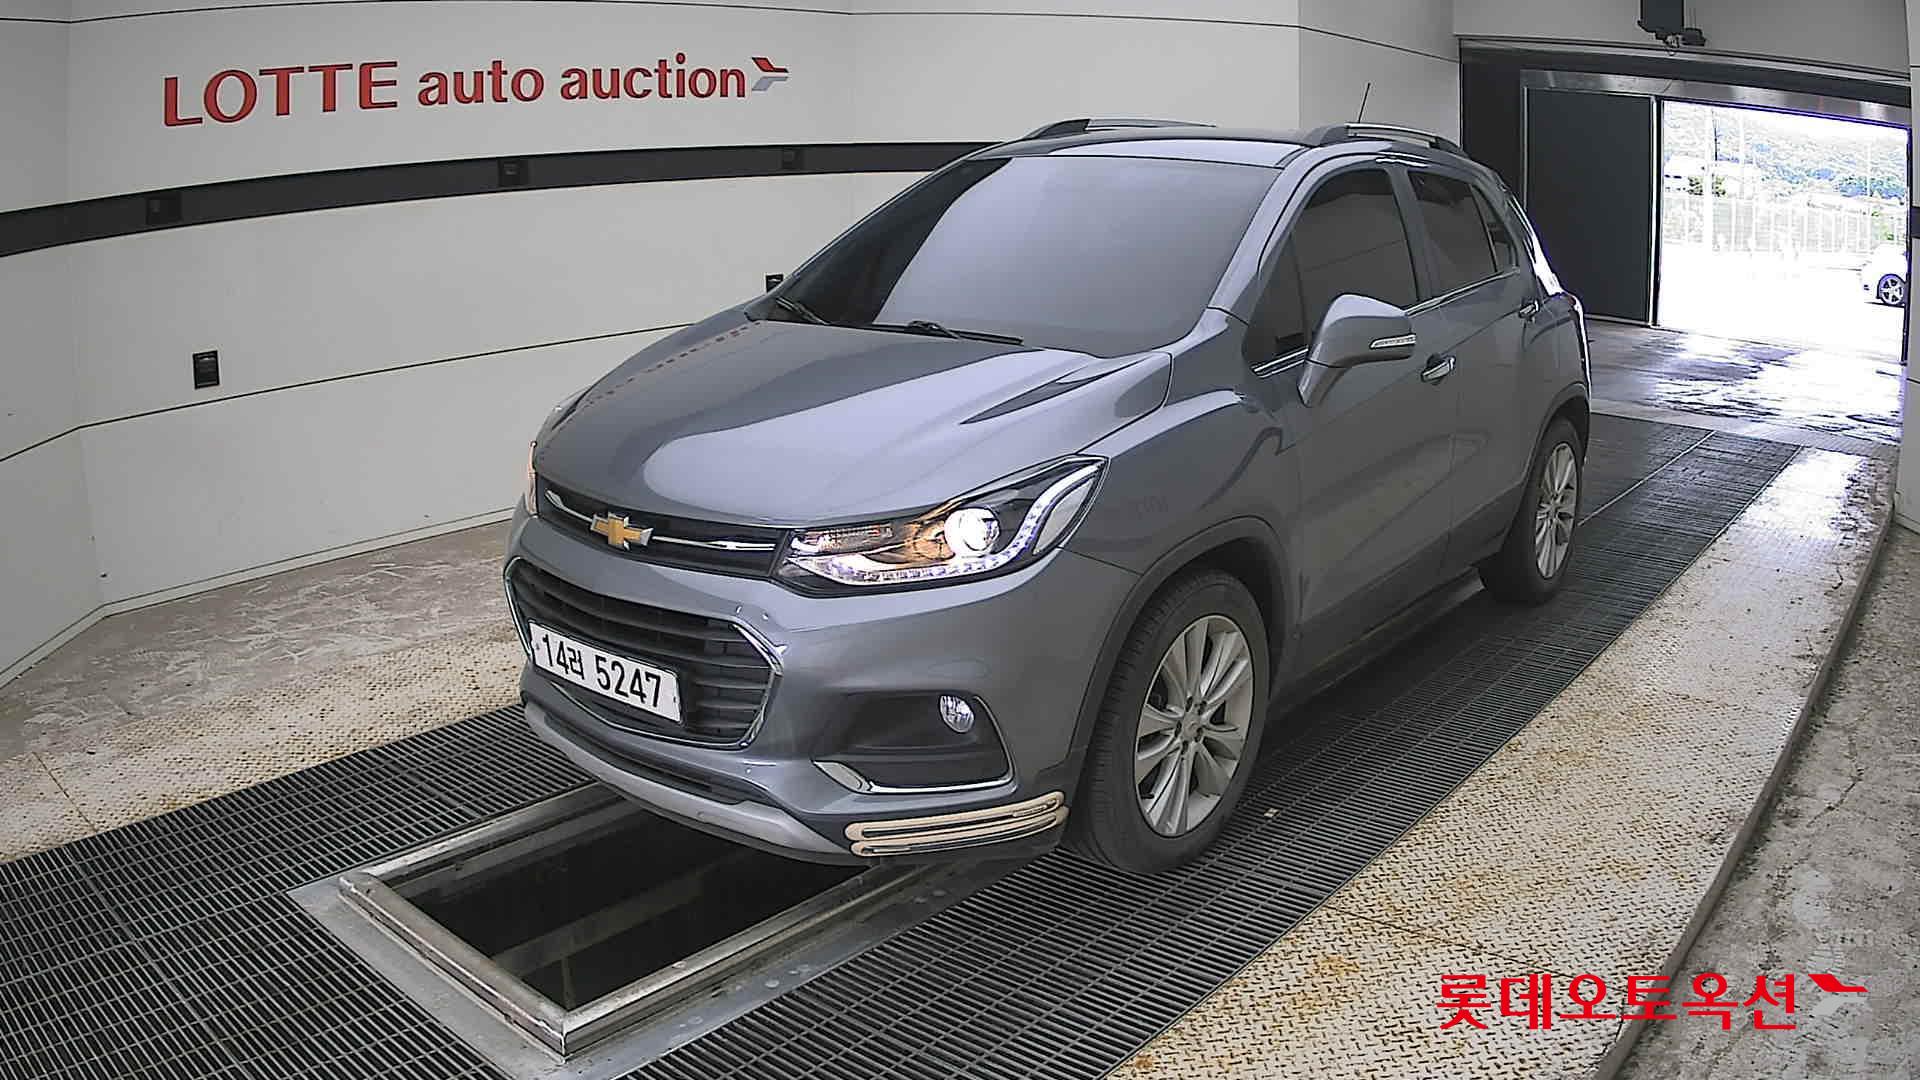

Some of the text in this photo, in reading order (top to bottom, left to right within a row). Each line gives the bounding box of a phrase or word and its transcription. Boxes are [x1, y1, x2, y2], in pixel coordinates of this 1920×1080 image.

[164, 52, 746, 127] LOTTE auto auction
[595, 654, 661, 708] 5247
